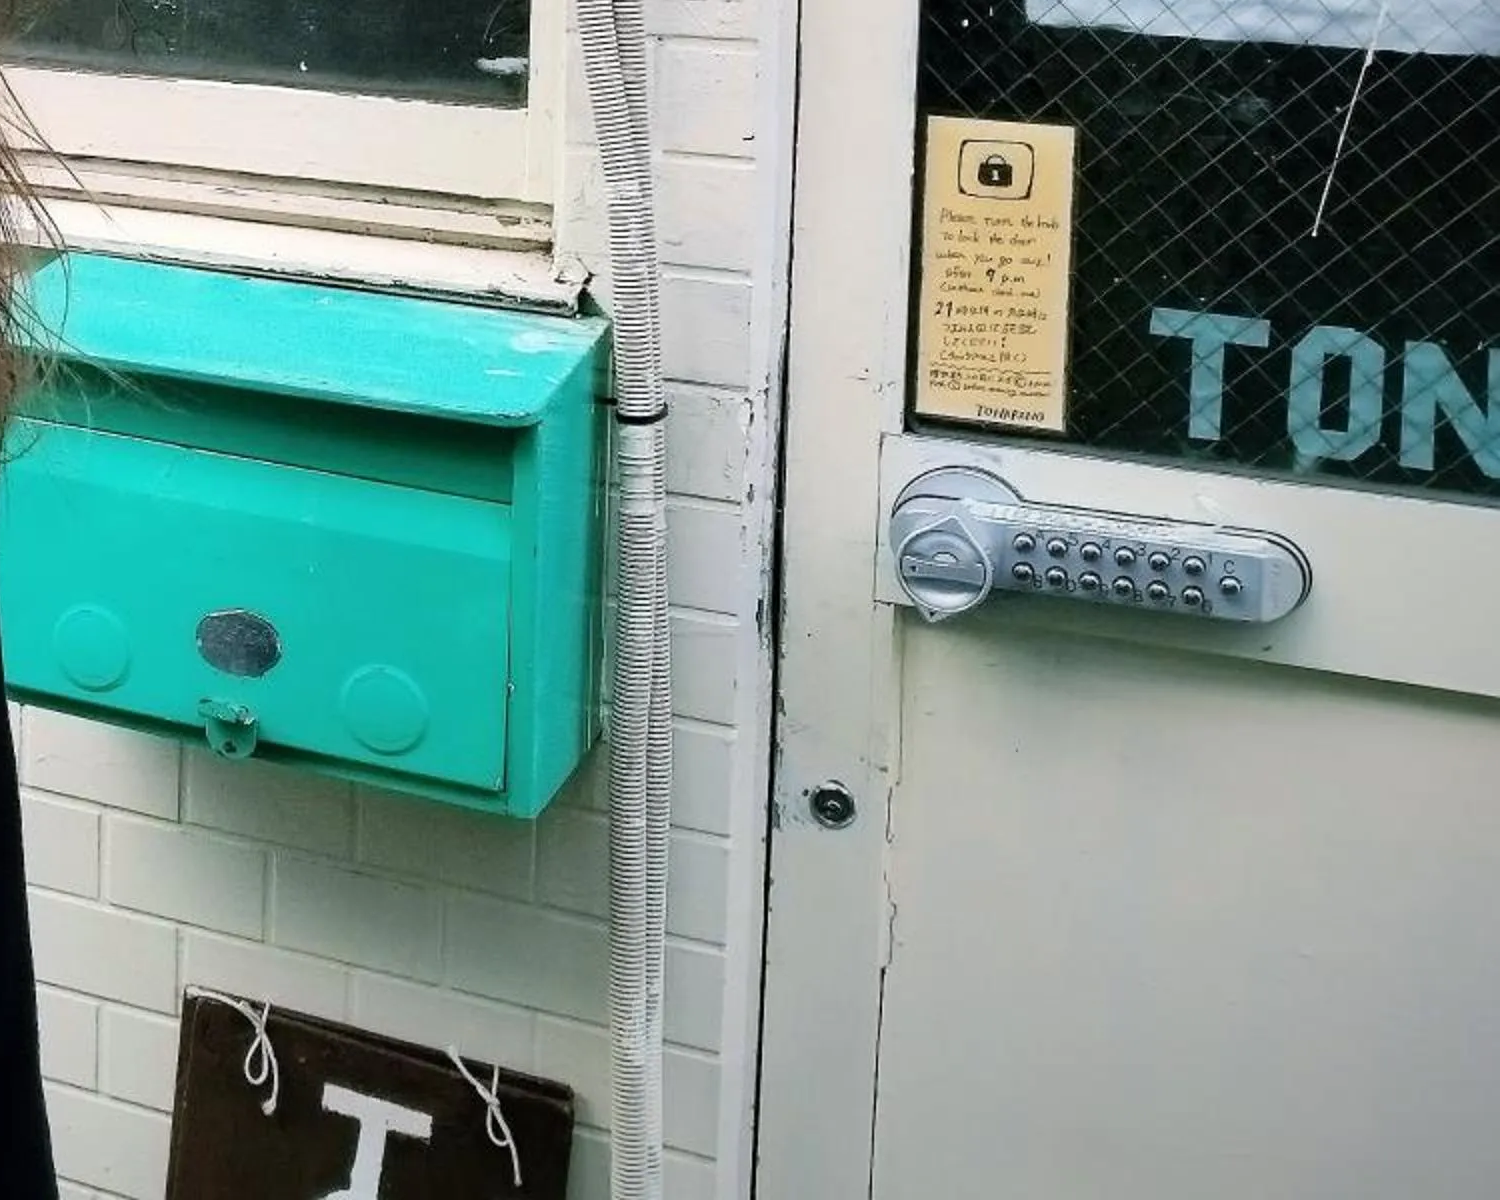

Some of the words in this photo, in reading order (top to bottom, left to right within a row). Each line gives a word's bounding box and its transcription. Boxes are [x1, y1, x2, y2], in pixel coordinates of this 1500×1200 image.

[985, 267, 996, 283] 9
[1149, 307, 1500, 480] TON
[1102, 539, 1111, 551] 4
[1171, 547, 1181, 561] 2
[1223, 559, 1236, 574] C
